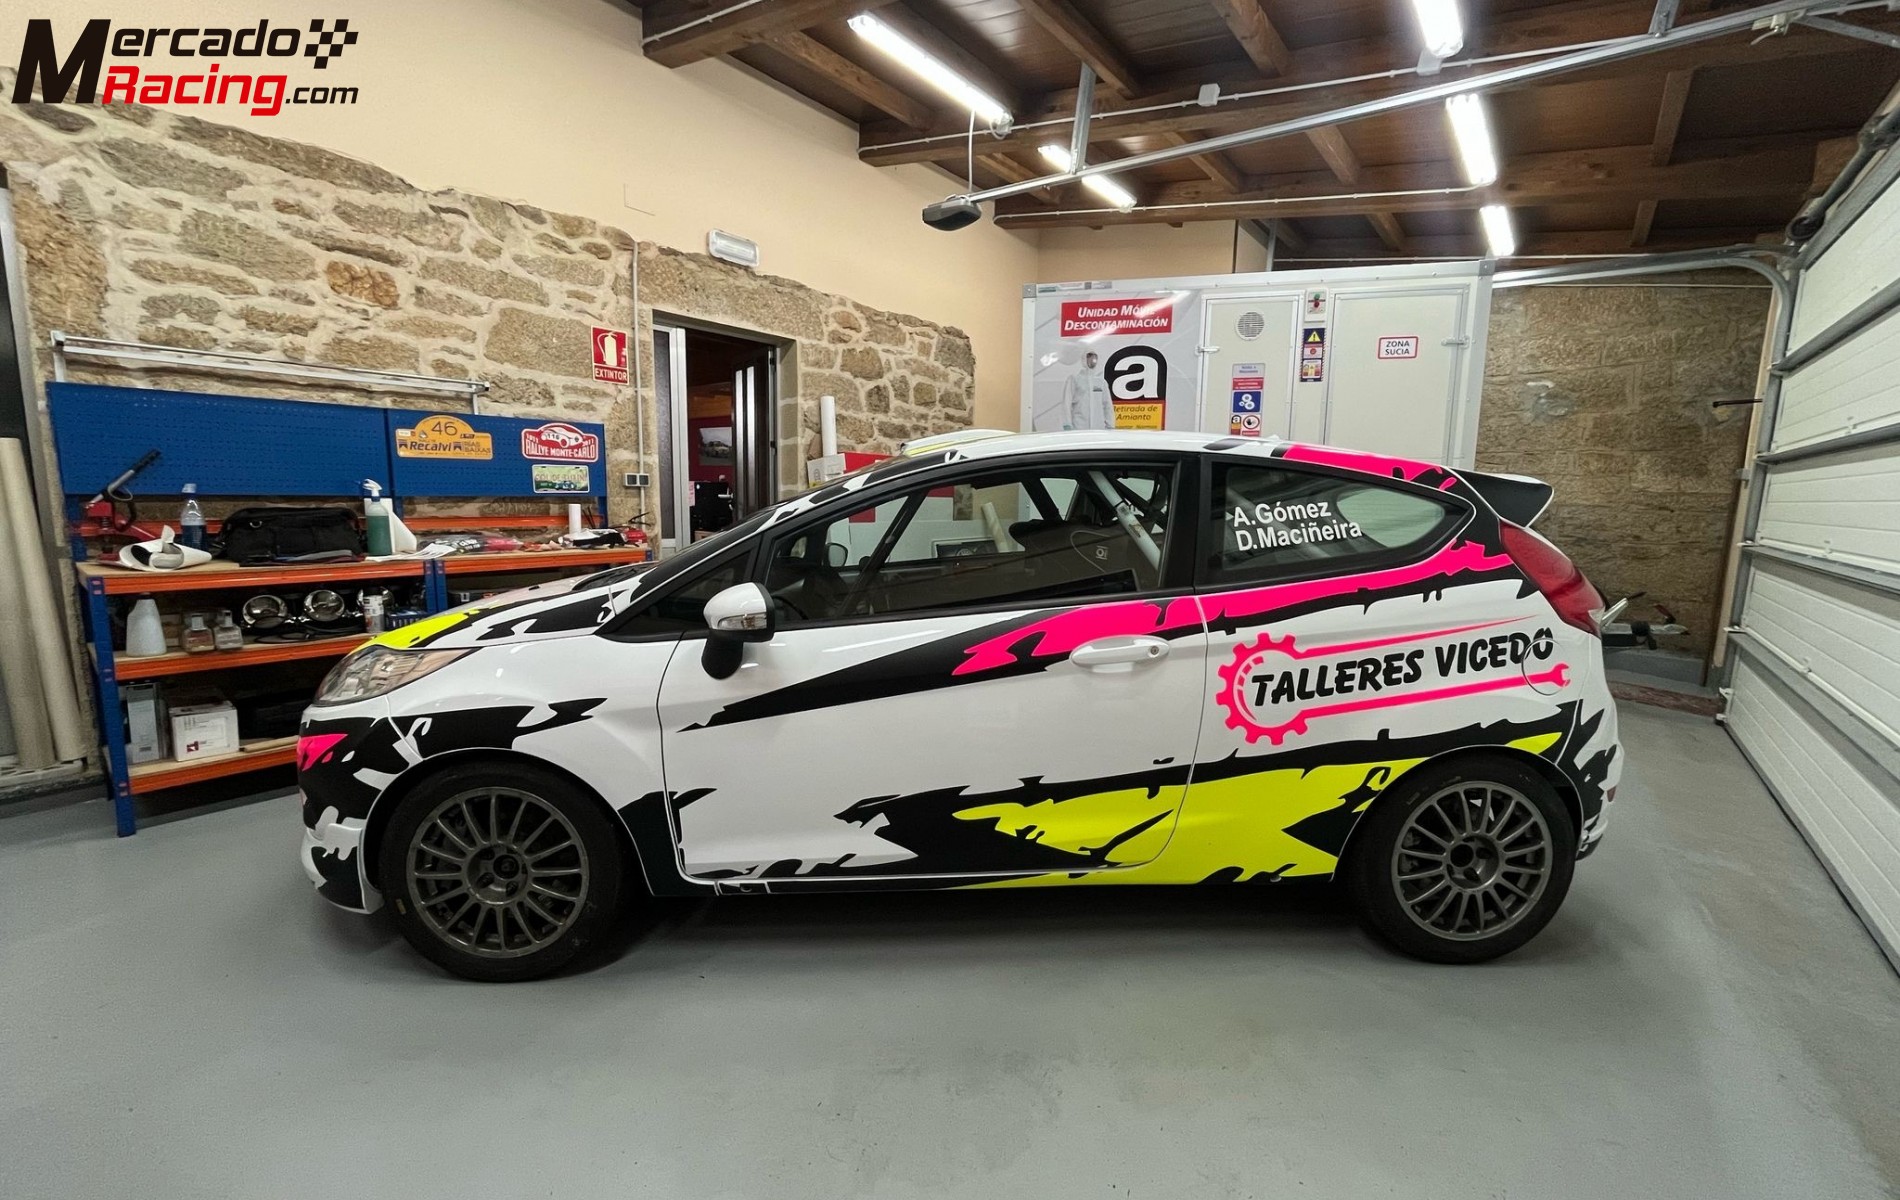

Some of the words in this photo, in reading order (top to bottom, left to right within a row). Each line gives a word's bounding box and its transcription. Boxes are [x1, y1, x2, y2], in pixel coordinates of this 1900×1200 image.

[1385, 348, 1410, 356] SUCIA
[1386, 340, 1410, 348] ZONA
[595, 368, 627, 381] EXTINTOR
[1112, 355, 1159, 400] a
[1116, 413, 1152, 421] Amianto
[431, 420, 458, 436] 46
[409, 441, 452, 451] Recalvi
[525, 438, 549, 456] RALLYE
[550, 443, 596, 459] MONTE-CARLO
[1233, 501, 1332, 527] A.Gómez
[1235, 519, 1363, 551] D.Maciñeira
[1435, 627, 1555, 678] VICEDO
[1251, 649, 1425, 707] TALLERES
